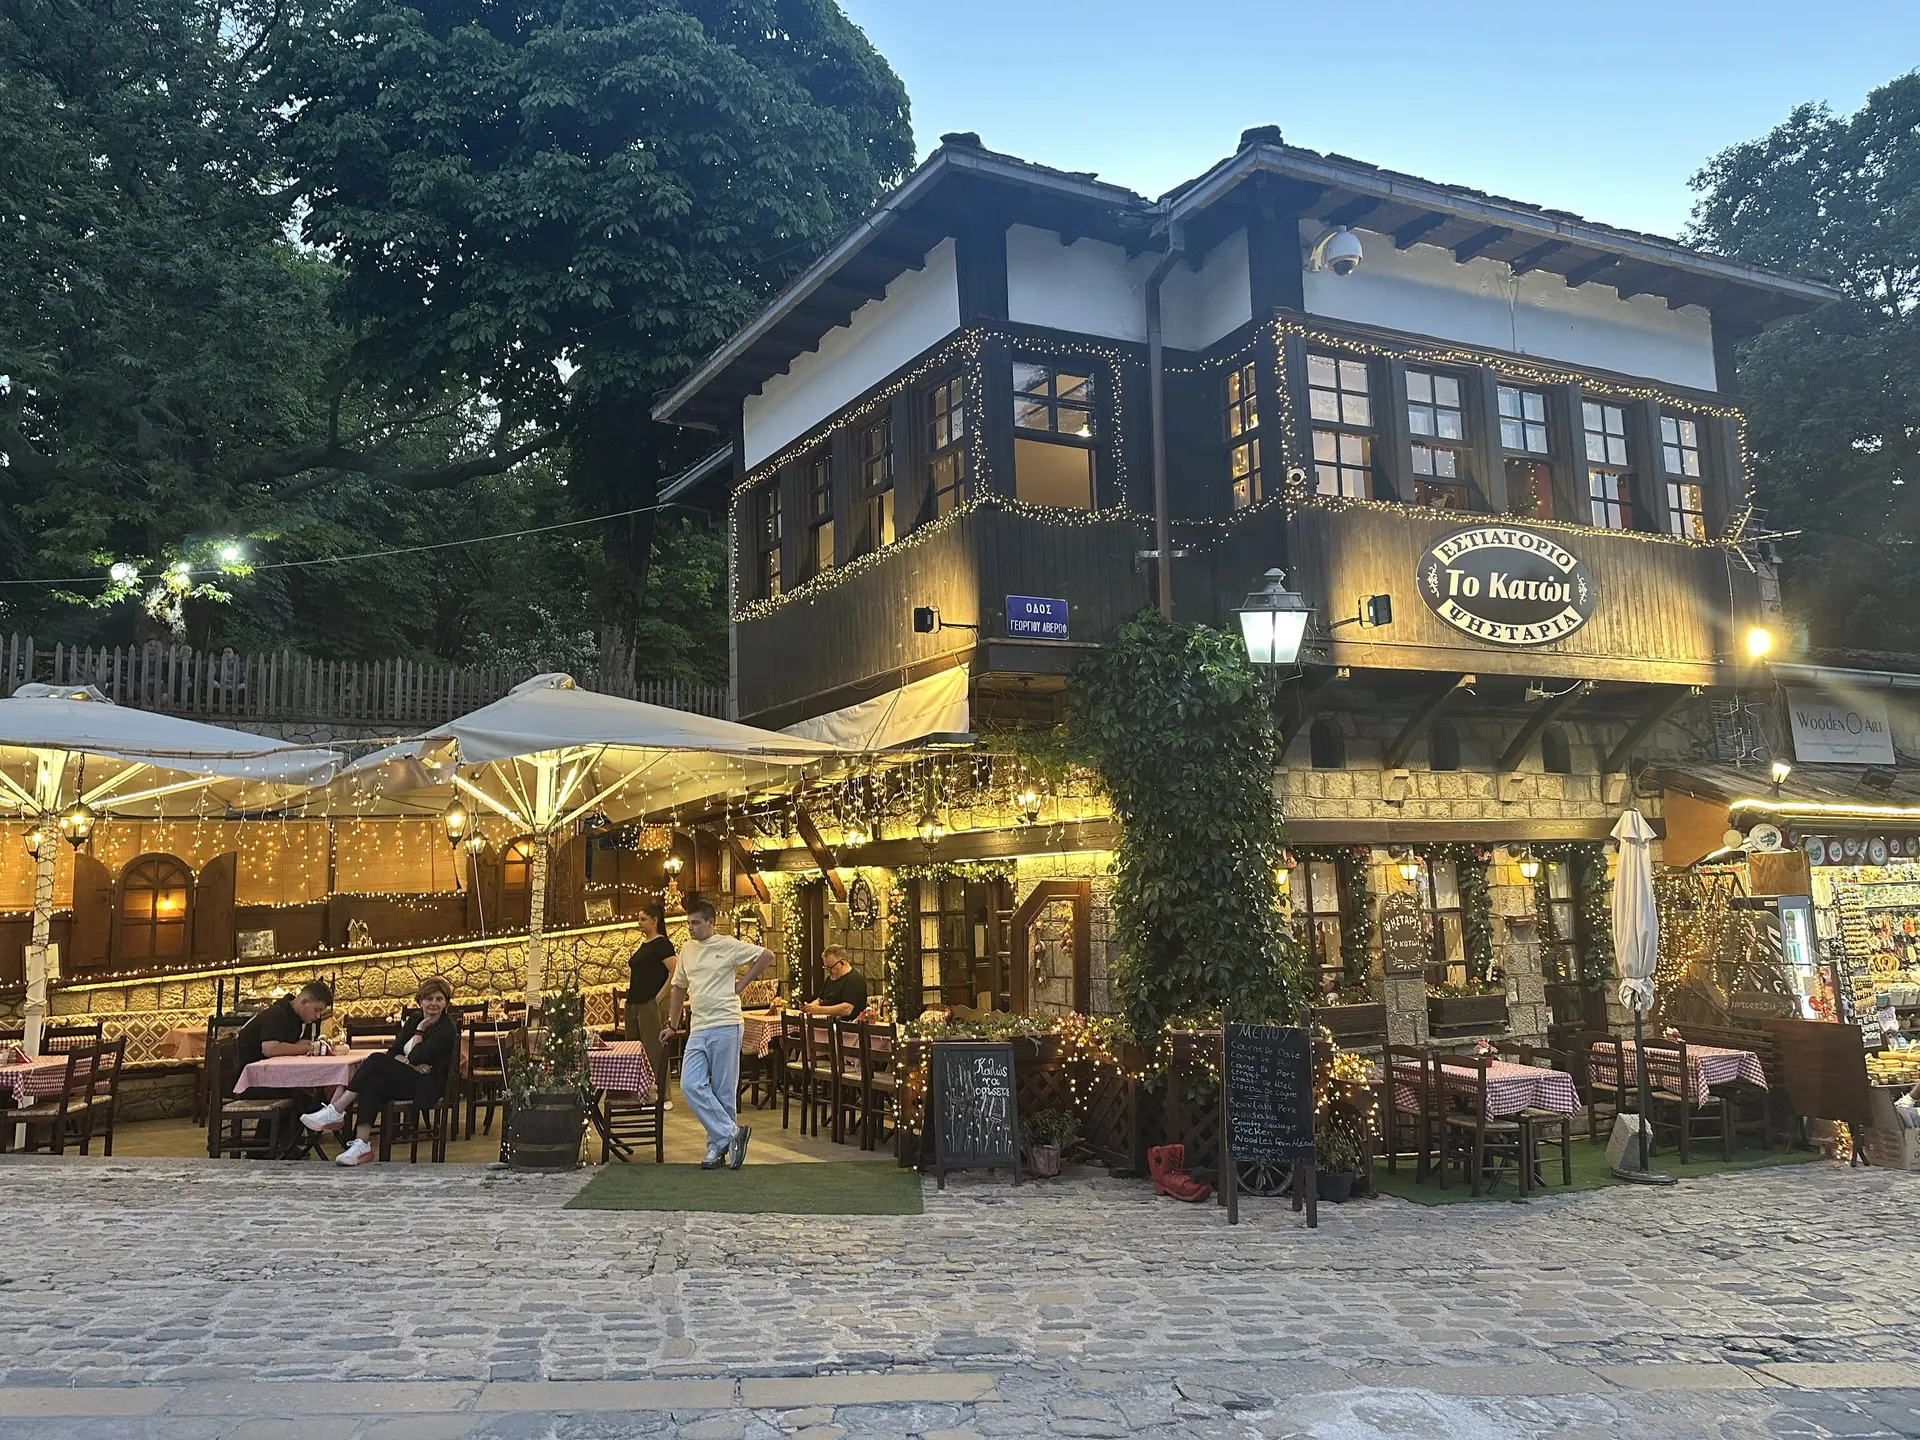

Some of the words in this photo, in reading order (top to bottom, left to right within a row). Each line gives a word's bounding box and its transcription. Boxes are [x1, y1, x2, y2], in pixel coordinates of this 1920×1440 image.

[1438, 530, 1571, 568] ΕΣΤΙΑΤΟΡΙΟ
[1446, 568, 1480, 597] Το
[1489, 572, 1572, 603] Κατώι
[1010, 619, 1040, 632] ΓΕΩΡΓΙΟΥ
[1042, 622, 1067, 634] ΑΒΕΡΩΦ
[1026, 603, 1052, 615] ΟΔΟΣ
[1449, 604, 1578, 641] ΨΗΣΤΑΡΙΑ
